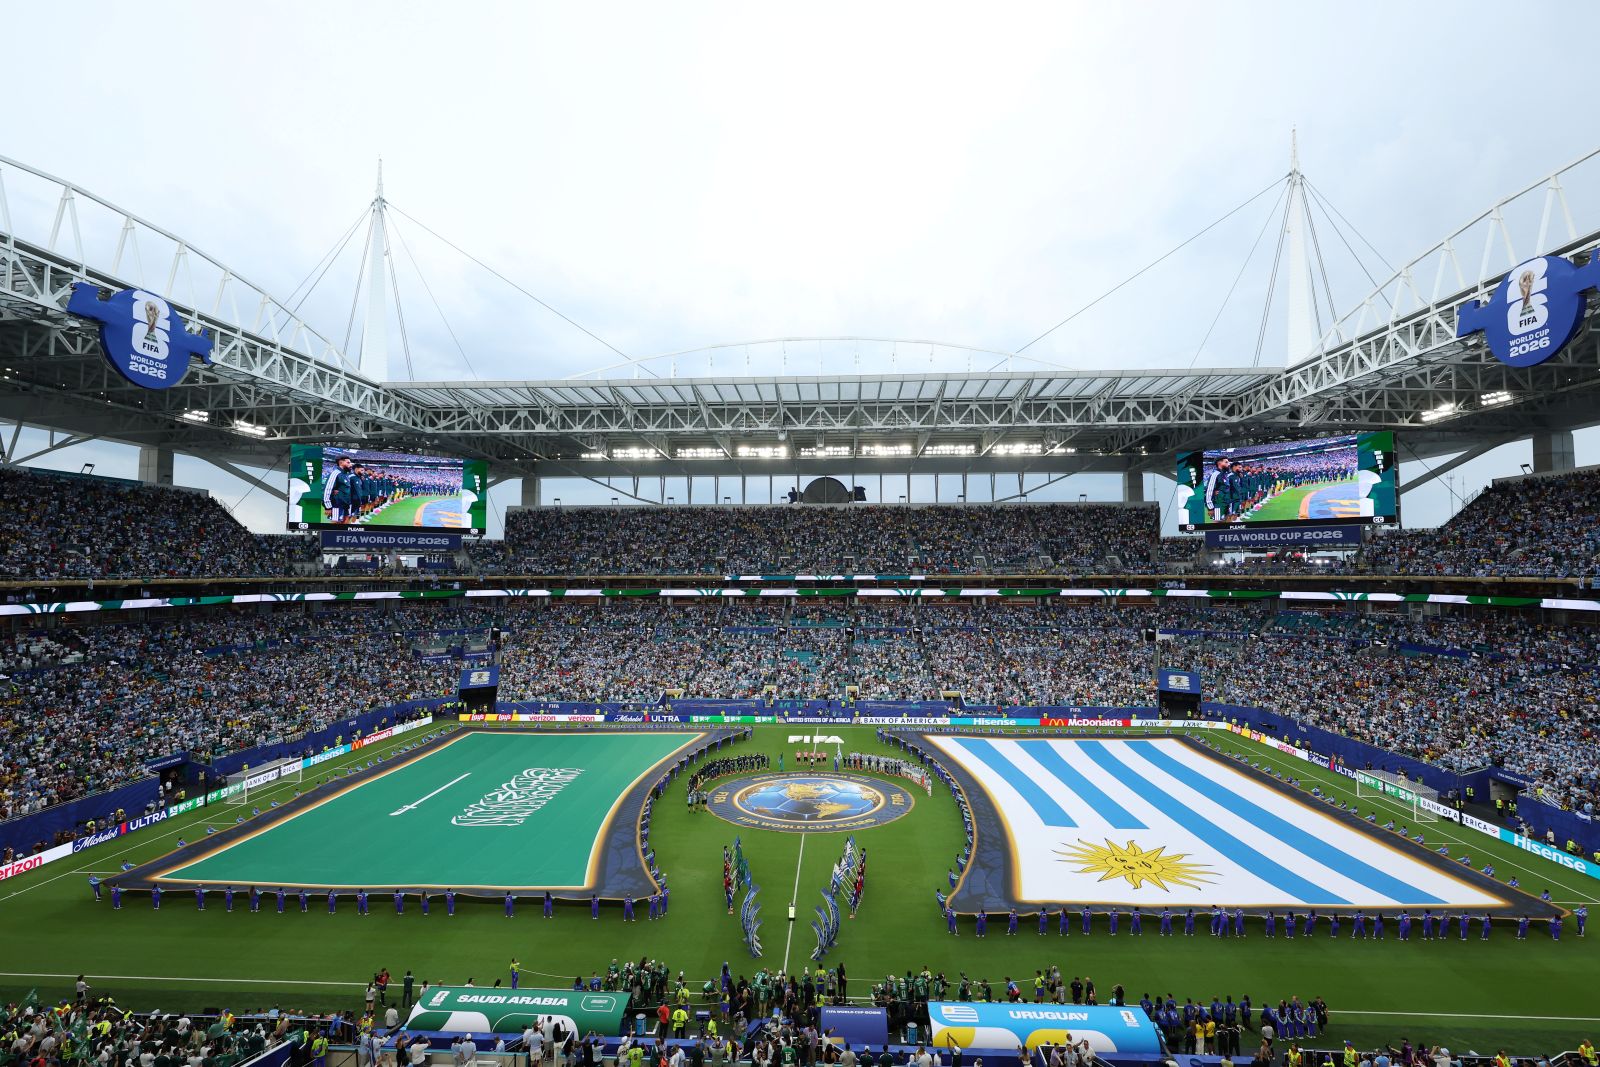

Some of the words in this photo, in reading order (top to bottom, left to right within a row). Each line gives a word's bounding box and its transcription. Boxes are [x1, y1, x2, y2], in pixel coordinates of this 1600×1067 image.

[1519, 316, 1537, 327] FIFA
[1509, 334, 1534, 346] WORLD
[1535, 329, 1550, 338] CUP
[143, 343, 159, 354] FIFA
[1509, 337, 1550, 357] 2026
[130, 354, 154, 366] WORLD
[154, 361, 167, 369] CUP
[129, 361, 167, 379] 2026
[360, 536, 395, 544] WORLD
[417, 537, 449, 545] 2026
[1219, 534, 1239, 542] FIFA
[1240, 533, 1278, 541] WORLD
[1280, 532, 1301, 540] CUP
[1303, 531, 1343, 539] 2026
[973, 718, 1016, 726] Hisense
[788, 735, 844, 743] FIFA
[311, 747, 344, 765] Hisense
[271, 765, 295, 778] AMRICA
[1335, 765, 1357, 778] ULTRA
[1422, 799, 1441, 812] BANK
[1443, 808, 1451, 818] OF
[1454, 812, 1488, 831] AERICA
[74, 827, 118, 852] Michelob
[130, 811, 167, 830] ULTRA
[1514, 834, 1586, 873] Hisense
[0, 856, 42, 880] erizon
[457, 995, 506, 1004] SAUDI
[508, 996, 568, 1006] ARABIA
[1009, 1010, 1088, 1020] URUGUAY
